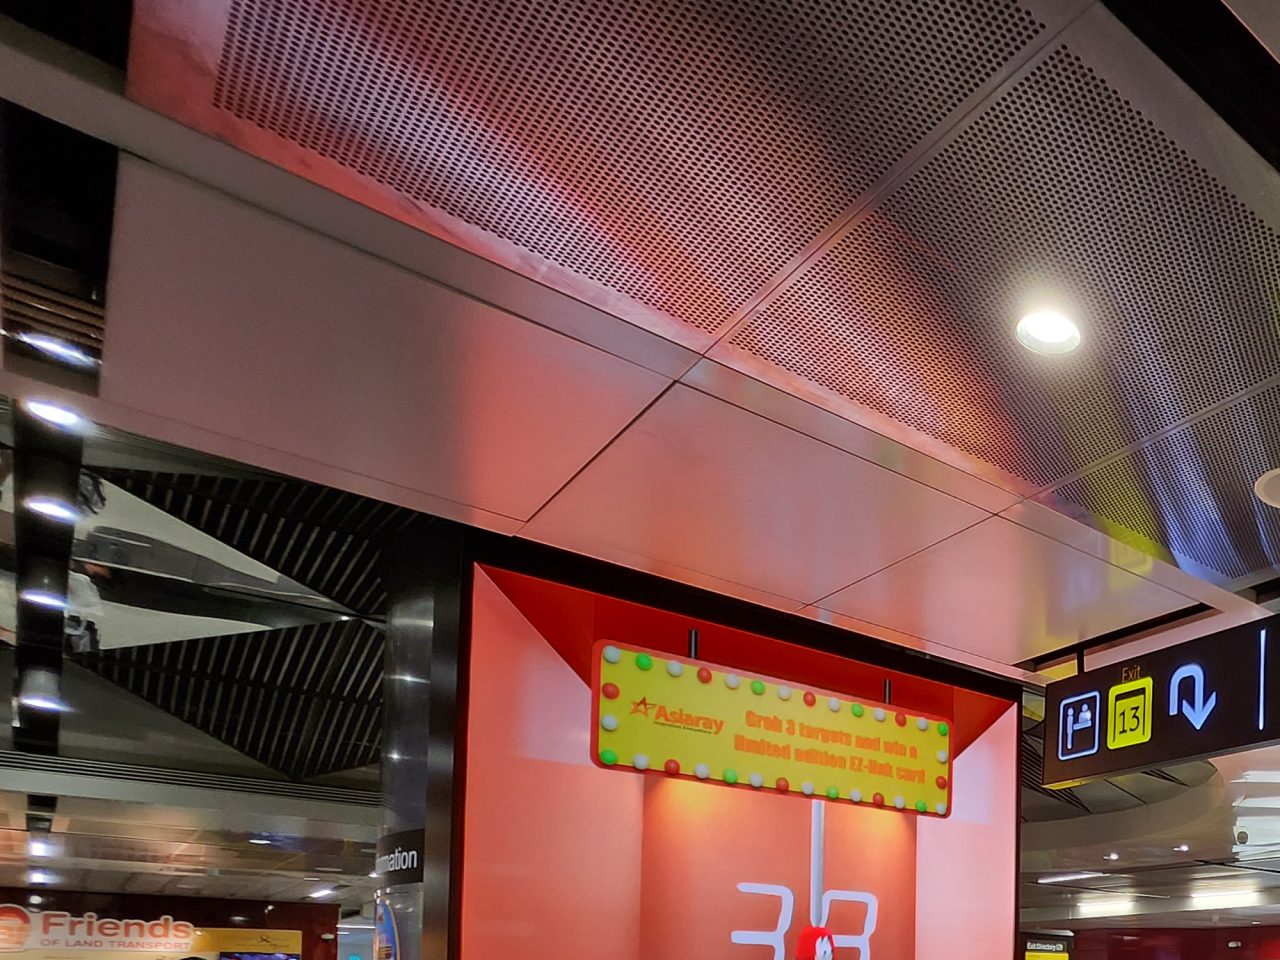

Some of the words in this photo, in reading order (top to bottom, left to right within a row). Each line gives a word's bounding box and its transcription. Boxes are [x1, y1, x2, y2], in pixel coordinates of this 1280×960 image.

[1122, 665, 1141, 683] Exit
[654, 704, 724, 735] Asiaray
[1119, 706, 1140, 735] 13
[745, 711, 782, 733] Grab
[784, 719, 796, 736] 3
[799, 723, 852, 746] targets
[855, 735, 881, 752] and
[883, 741, 907, 757] win
[909, 746, 918, 759] a
[734, 734, 791, 760] limited
[794, 748, 847, 769] edition
[849, 755, 894, 778] EZ-link
[895, 766, 926, 784] card
[41, 913, 193, 939] Friends
[40, 938, 61, 947] OF
[65, 939, 103, 948] LAND
[110, 940, 191, 951] TRANSPORT
